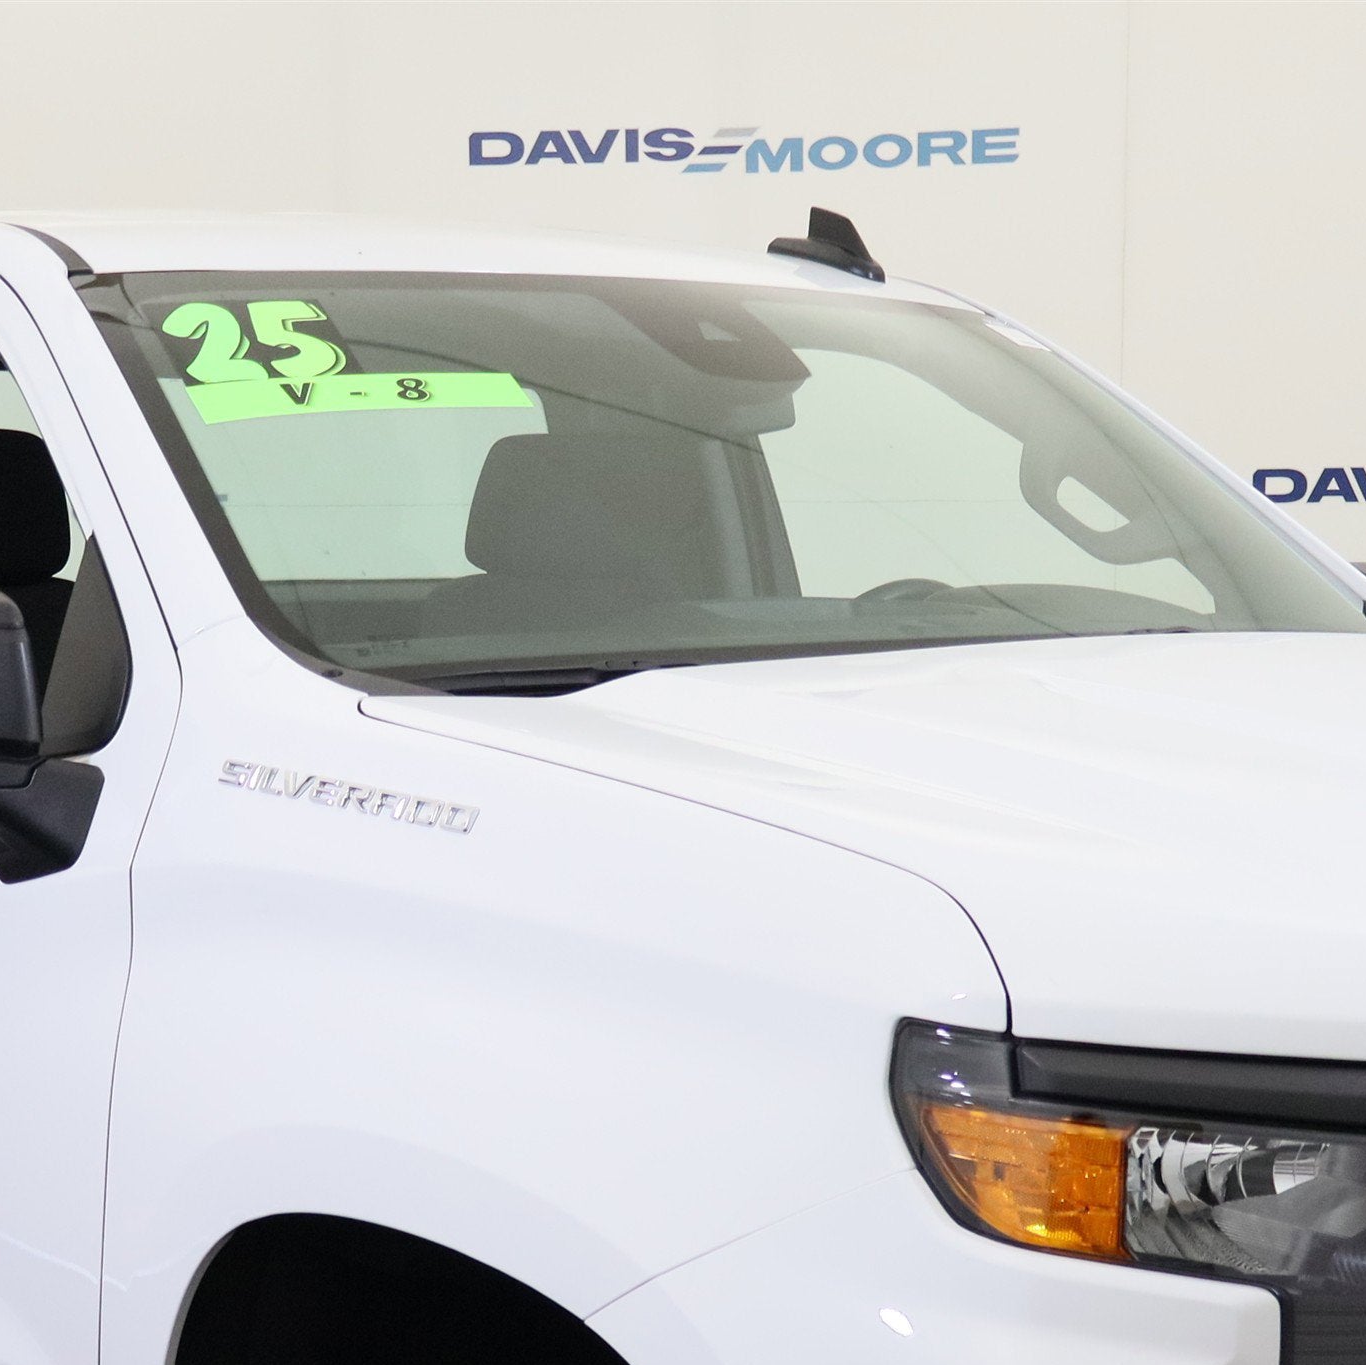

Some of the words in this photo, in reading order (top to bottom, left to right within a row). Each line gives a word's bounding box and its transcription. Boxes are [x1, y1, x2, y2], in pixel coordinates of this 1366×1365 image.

[469, 128, 695, 166] DAVIS
[744, 127, 1020, 174] MOORE
[161, 300, 347, 384] 25
[218, 758, 480, 835] SILVERADO
